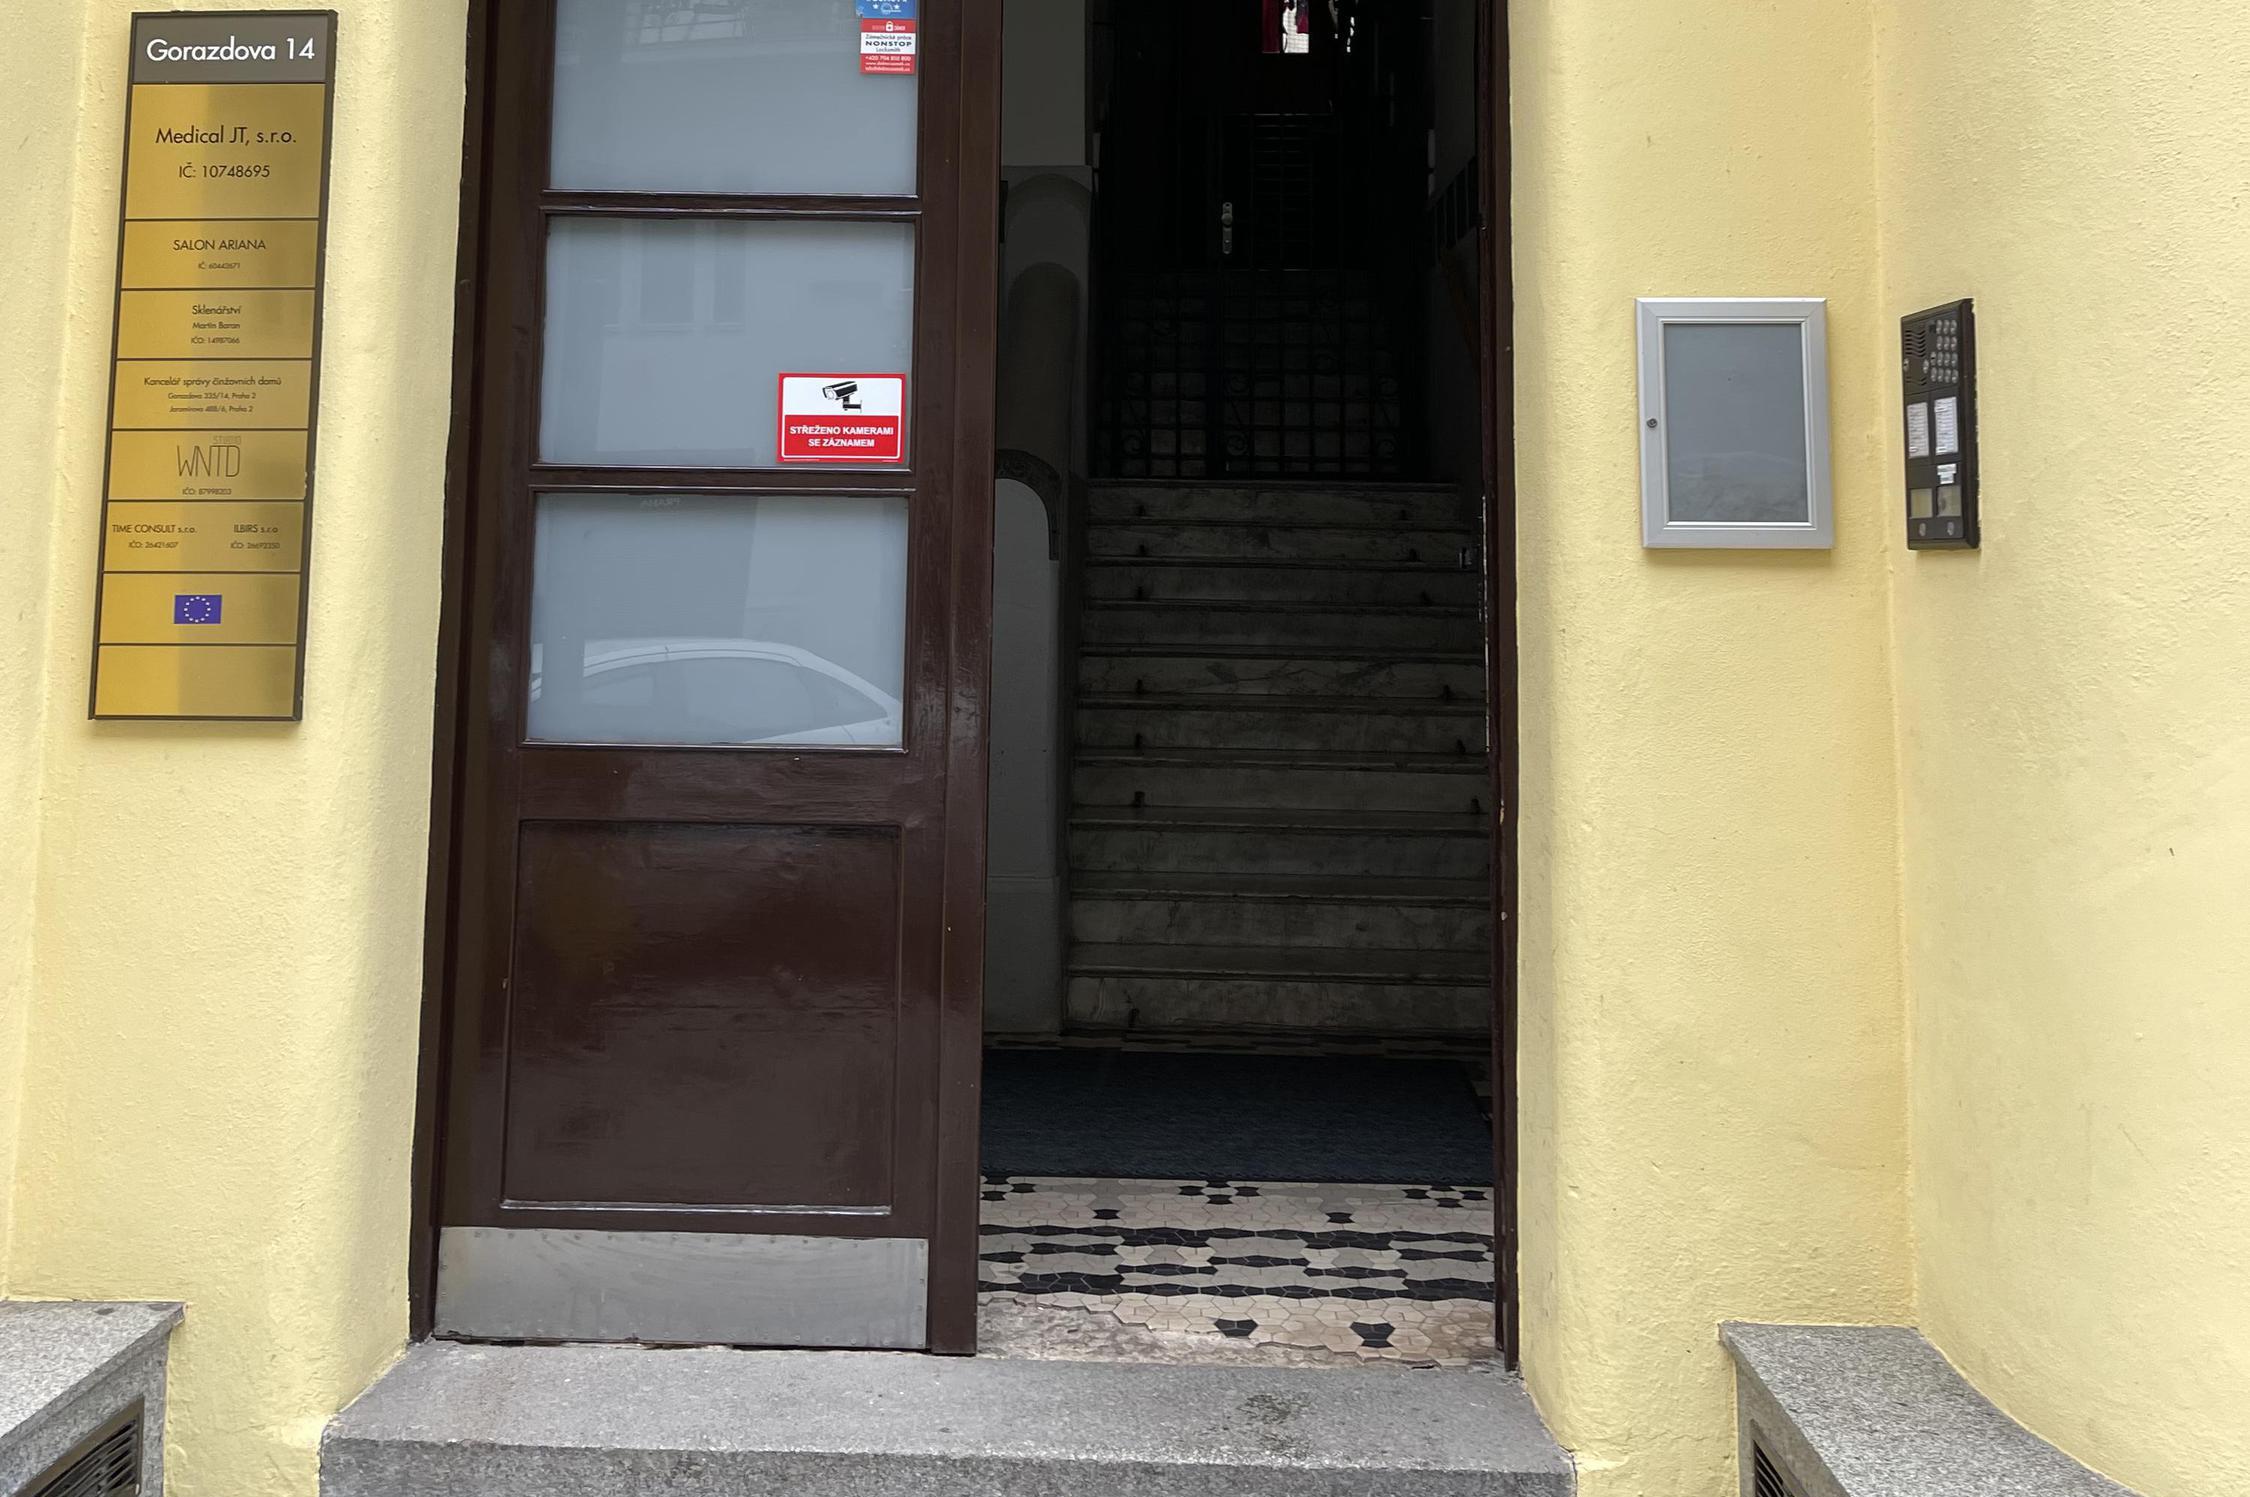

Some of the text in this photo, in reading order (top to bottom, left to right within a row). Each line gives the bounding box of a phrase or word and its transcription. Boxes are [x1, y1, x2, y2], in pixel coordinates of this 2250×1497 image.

[146, 36, 315, 61] Gorazdova 14
[155, 125, 297, 146] Medical JT, s.r.o.
[179, 162, 270, 178] IČ: 10748695
[173, 239, 266, 251] SALON ARIANA
[192, 304, 241, 314] Sklenářství
[144, 376, 281, 388] Kancelář správy činžovních domů
[231, 392, 251, 400] Praha
[789, 424, 894, 435] STŘEŽENO KAMERAMI
[808, 437, 875, 447] SE ZÁZNAMEM
[112, 524, 132, 533] TIME
[134, 524, 176, 533] CONSULT
